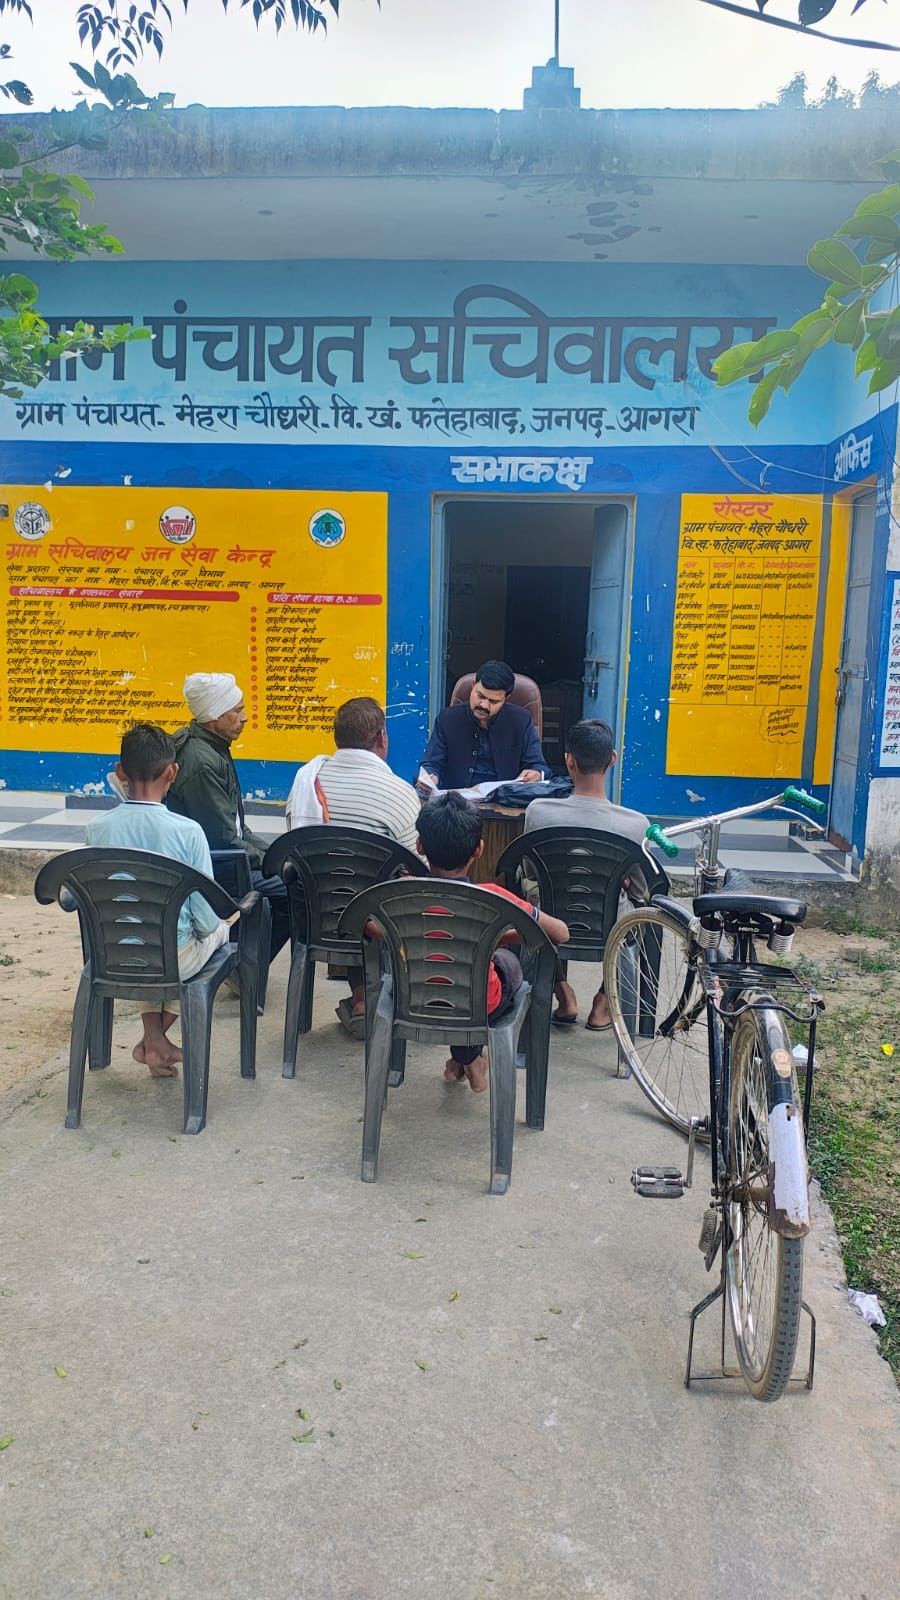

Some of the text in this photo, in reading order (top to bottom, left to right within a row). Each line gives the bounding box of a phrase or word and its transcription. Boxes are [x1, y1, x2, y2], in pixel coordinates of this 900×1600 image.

[144, 300, 372, 387] पंचायत
[389, 284, 777, 391] सचिवालय
[15, 401, 66, 430] ग्राम
[173, 394, 241, 432] मेहरा
[616, 406, 701, 437] आगरा
[450, 455, 594, 491] सभाकक्ष
[834, 433, 873, 481] ऑफिस
[713, 496, 774, 521] रोस्टर
[683, 523, 704, 534] ग्राम
[749, 520, 775, 537] मेहरा
[775, 517, 809, 536] चौधरी
[6, 537, 276, 568] ग्राम सचिवालय जन सेवा केन्द्र
